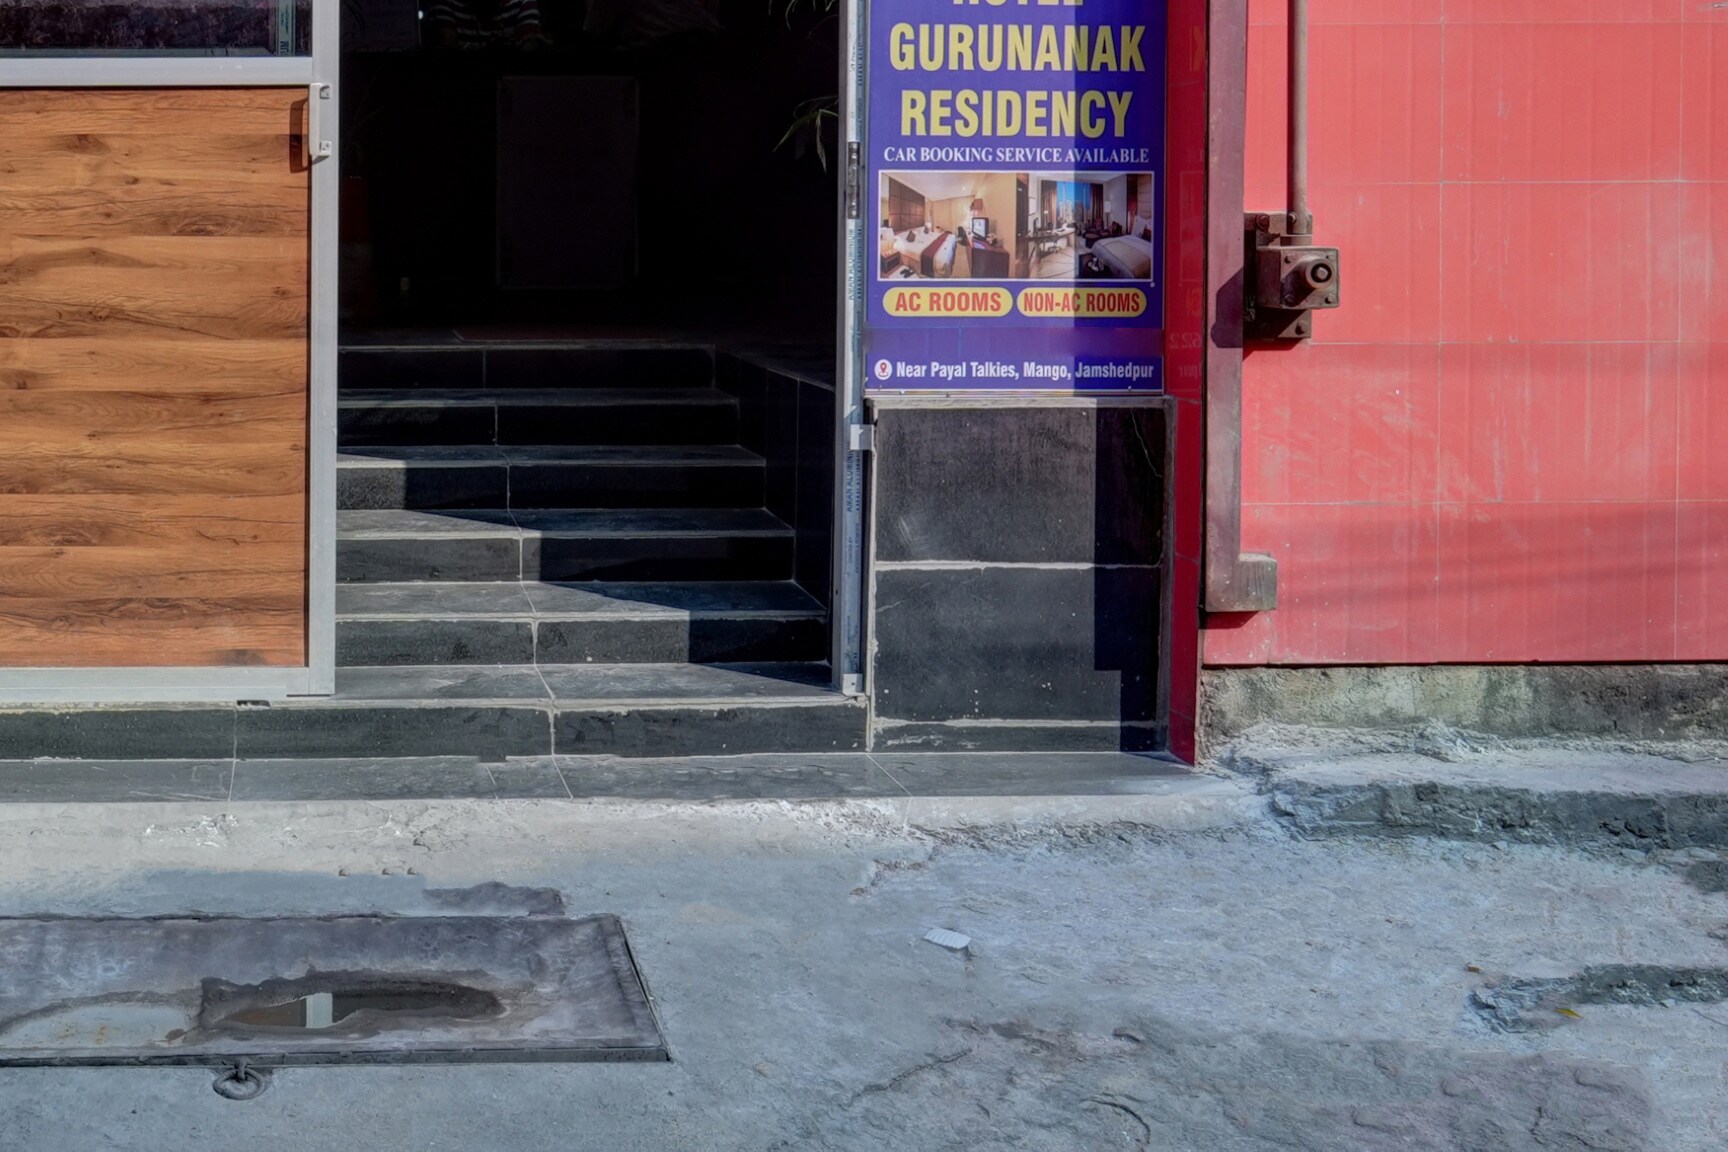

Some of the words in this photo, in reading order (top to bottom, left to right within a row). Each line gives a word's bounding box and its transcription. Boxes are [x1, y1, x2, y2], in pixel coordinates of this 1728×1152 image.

[889, 22, 1146, 72] GURUNANAK
[901, 89, 1133, 138] RESIDENCY
[883, 146, 917, 162] CAR
[920, 147, 993, 163] BOOKING
[996, 147, 1063, 163] SERVICE
[1065, 147, 1150, 164] AVAILABLE
[895, 291, 922, 312] AC
[930, 291, 1002, 313] ROOMS
[1023, 291, 1082, 313] NON-AC
[1085, 292, 1141, 313] ROOMS
[896, 361, 928, 378] Near
[930, 362, 967, 381] Payal
[971, 362, 1019, 381] Talkies,
[1023, 362, 1072, 382] Mango,
[1075, 362, 1154, 381] Jamshedpur
